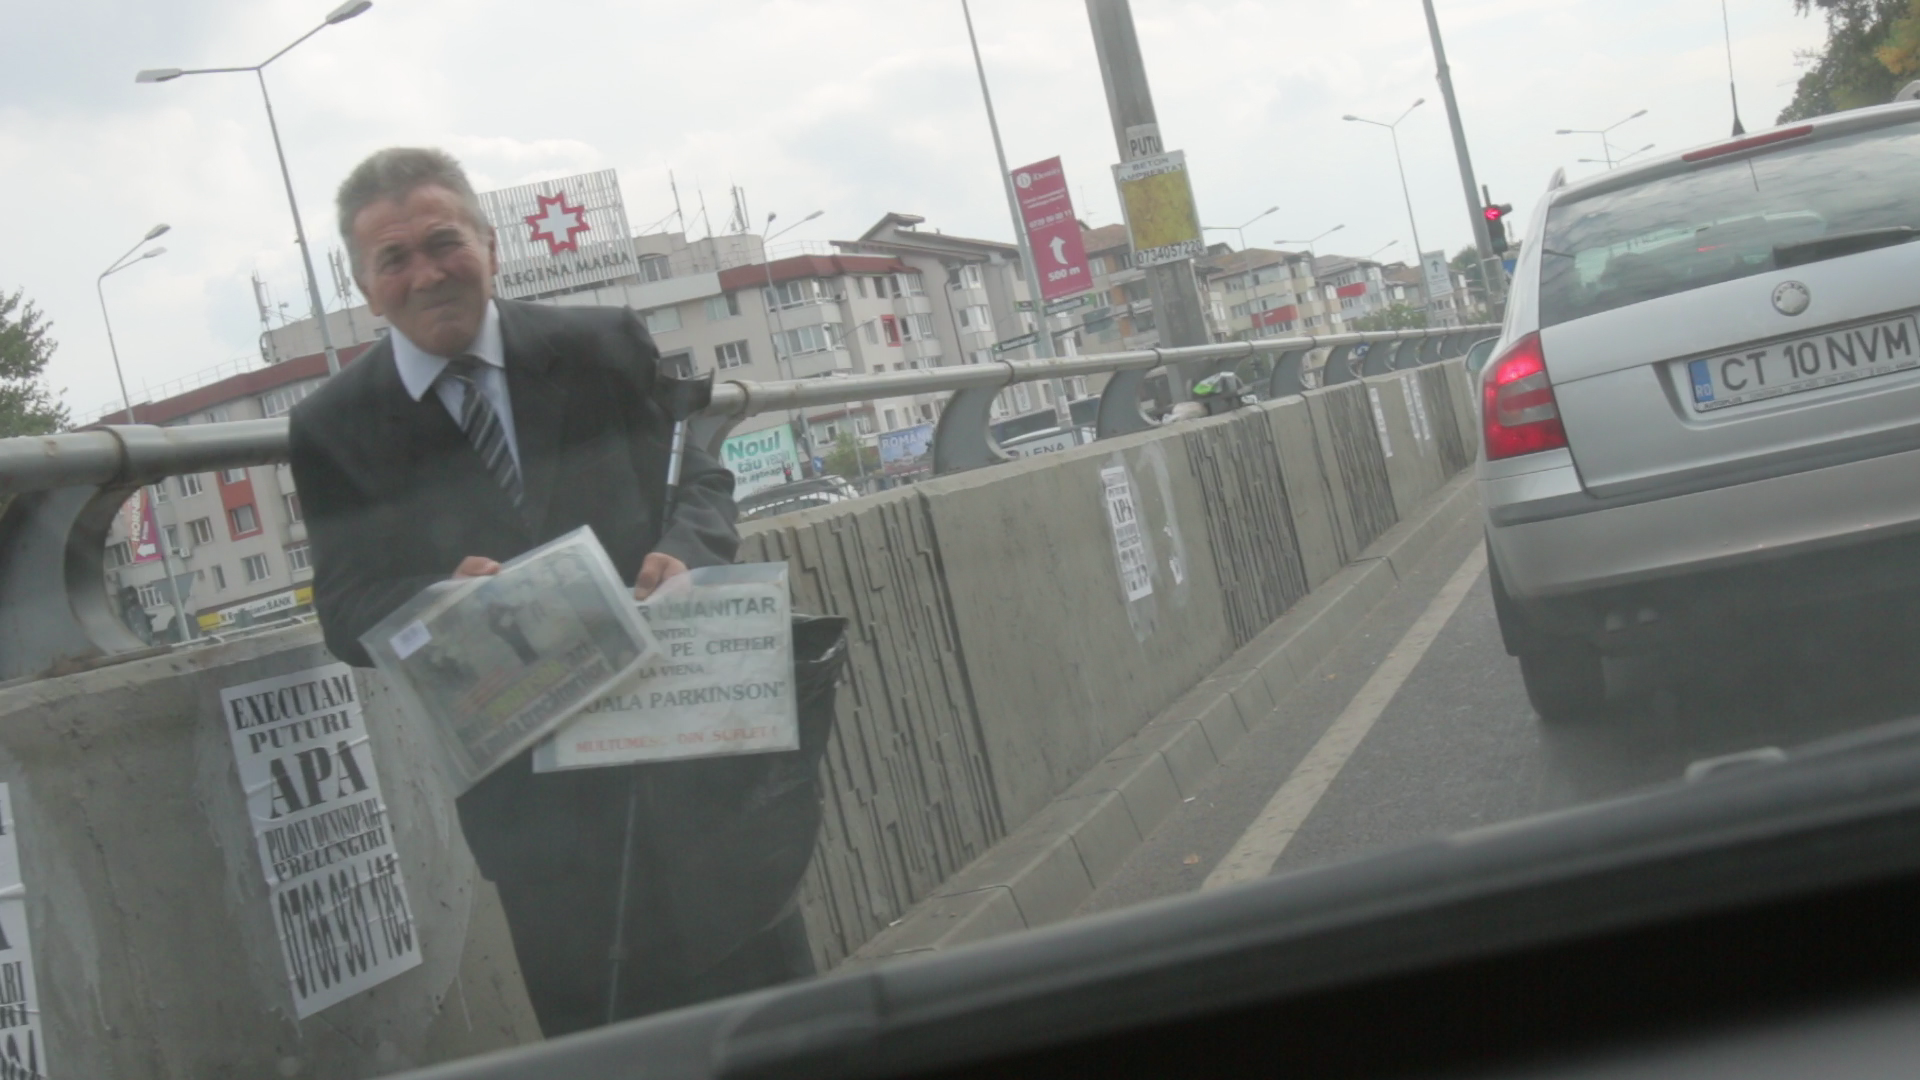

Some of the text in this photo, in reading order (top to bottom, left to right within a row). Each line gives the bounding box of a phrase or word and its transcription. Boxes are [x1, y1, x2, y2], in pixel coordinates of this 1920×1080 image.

[1132, 158, 1169, 171] BETON
[502, 251, 631, 288] REGINA MARIA
[1048, 266, 1080, 282] 500 m
[1721, 322, 1911, 391] CT 10 NVM
[727, 431, 780, 462] Noul
[670, 635, 776, 657] PE CREIER
[639, 663, 704, 679] LA VIENA
[229, 674, 354, 730] EXECUTAM
[249, 709, 352, 753] PUTURI
[270, 740, 369, 819] APA
[274, 827, 387, 881] PRELUNGIRI
[278, 879, 341, 999] 0766
